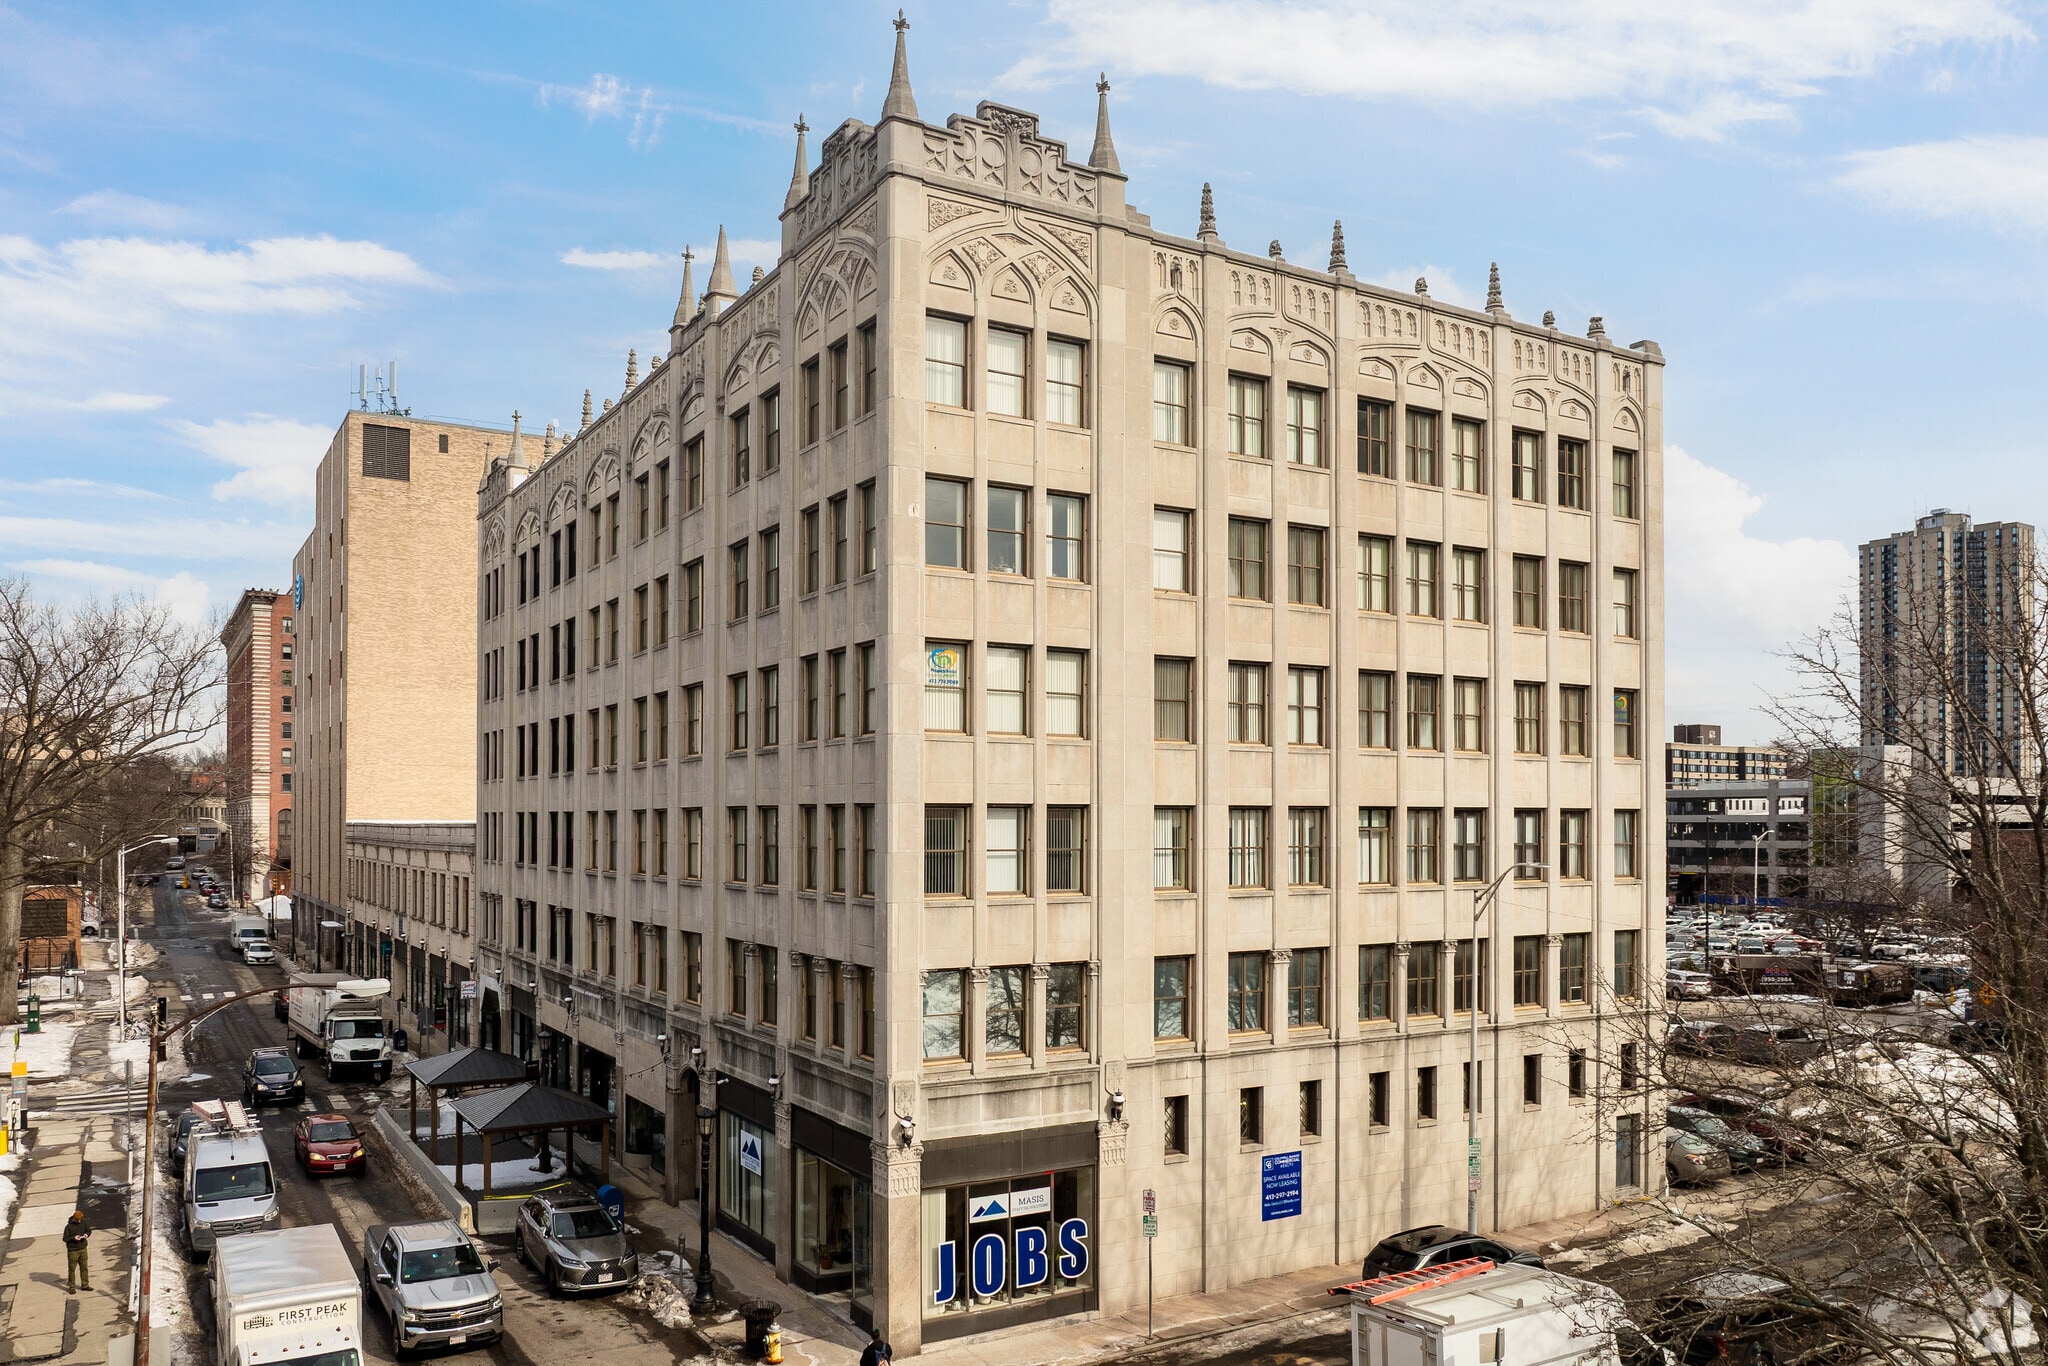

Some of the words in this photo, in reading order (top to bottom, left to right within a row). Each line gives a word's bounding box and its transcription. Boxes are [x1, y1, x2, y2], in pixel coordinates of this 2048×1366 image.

[1263, 1175, 1277, 1183] SPACE
[1278, 1171, 1300, 1180] AVAILABLE
[1279, 1179, 1298, 1187] LEASING
[1018, 1194, 1045, 1206] MASIS
[934, 1217, 1088, 1304] JOBS
[279, 1308, 312, 1321] FIRST
[316, 1303, 347, 1315] PEAK
[281, 1312, 344, 1325] CONSTRUCTION
